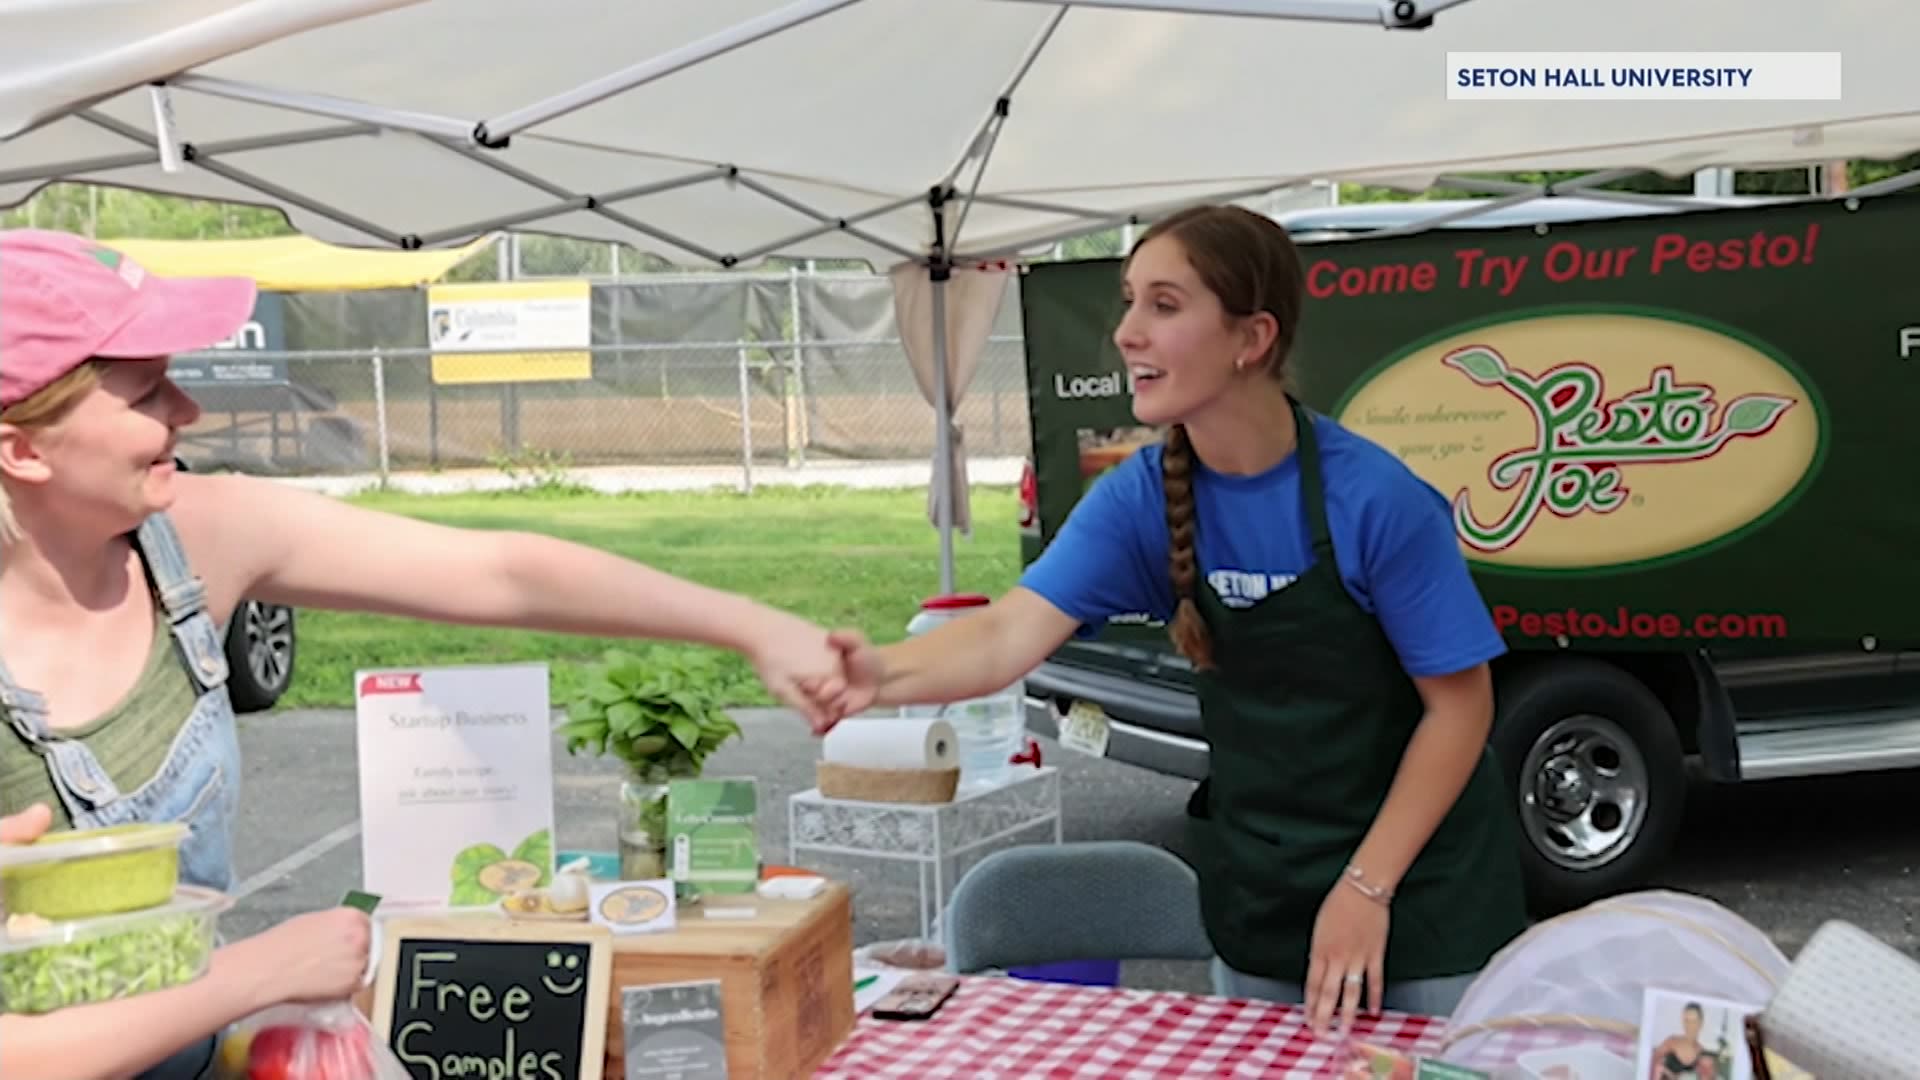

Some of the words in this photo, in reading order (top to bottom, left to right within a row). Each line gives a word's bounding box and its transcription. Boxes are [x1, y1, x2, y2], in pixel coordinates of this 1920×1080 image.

[1305, 259, 1437, 297] Come
[1454, 249, 1528, 296] Try
[1542, 241, 1637, 282] Our
[1650, 224, 1820, 274] Pesto!
[1054, 371, 1120, 398] Local
[1502, 362, 1718, 452] Pesto
[1453, 445, 1630, 552] Joe
[1492, 605, 1788, 639] PestoJoe.com
[375, 675, 412, 689] NEW
[389, 711, 450, 731] Startup
[455, 710, 528, 727] Business
[409, 952, 533, 1022] Free
[397, 1020, 563, 1080] Samples
